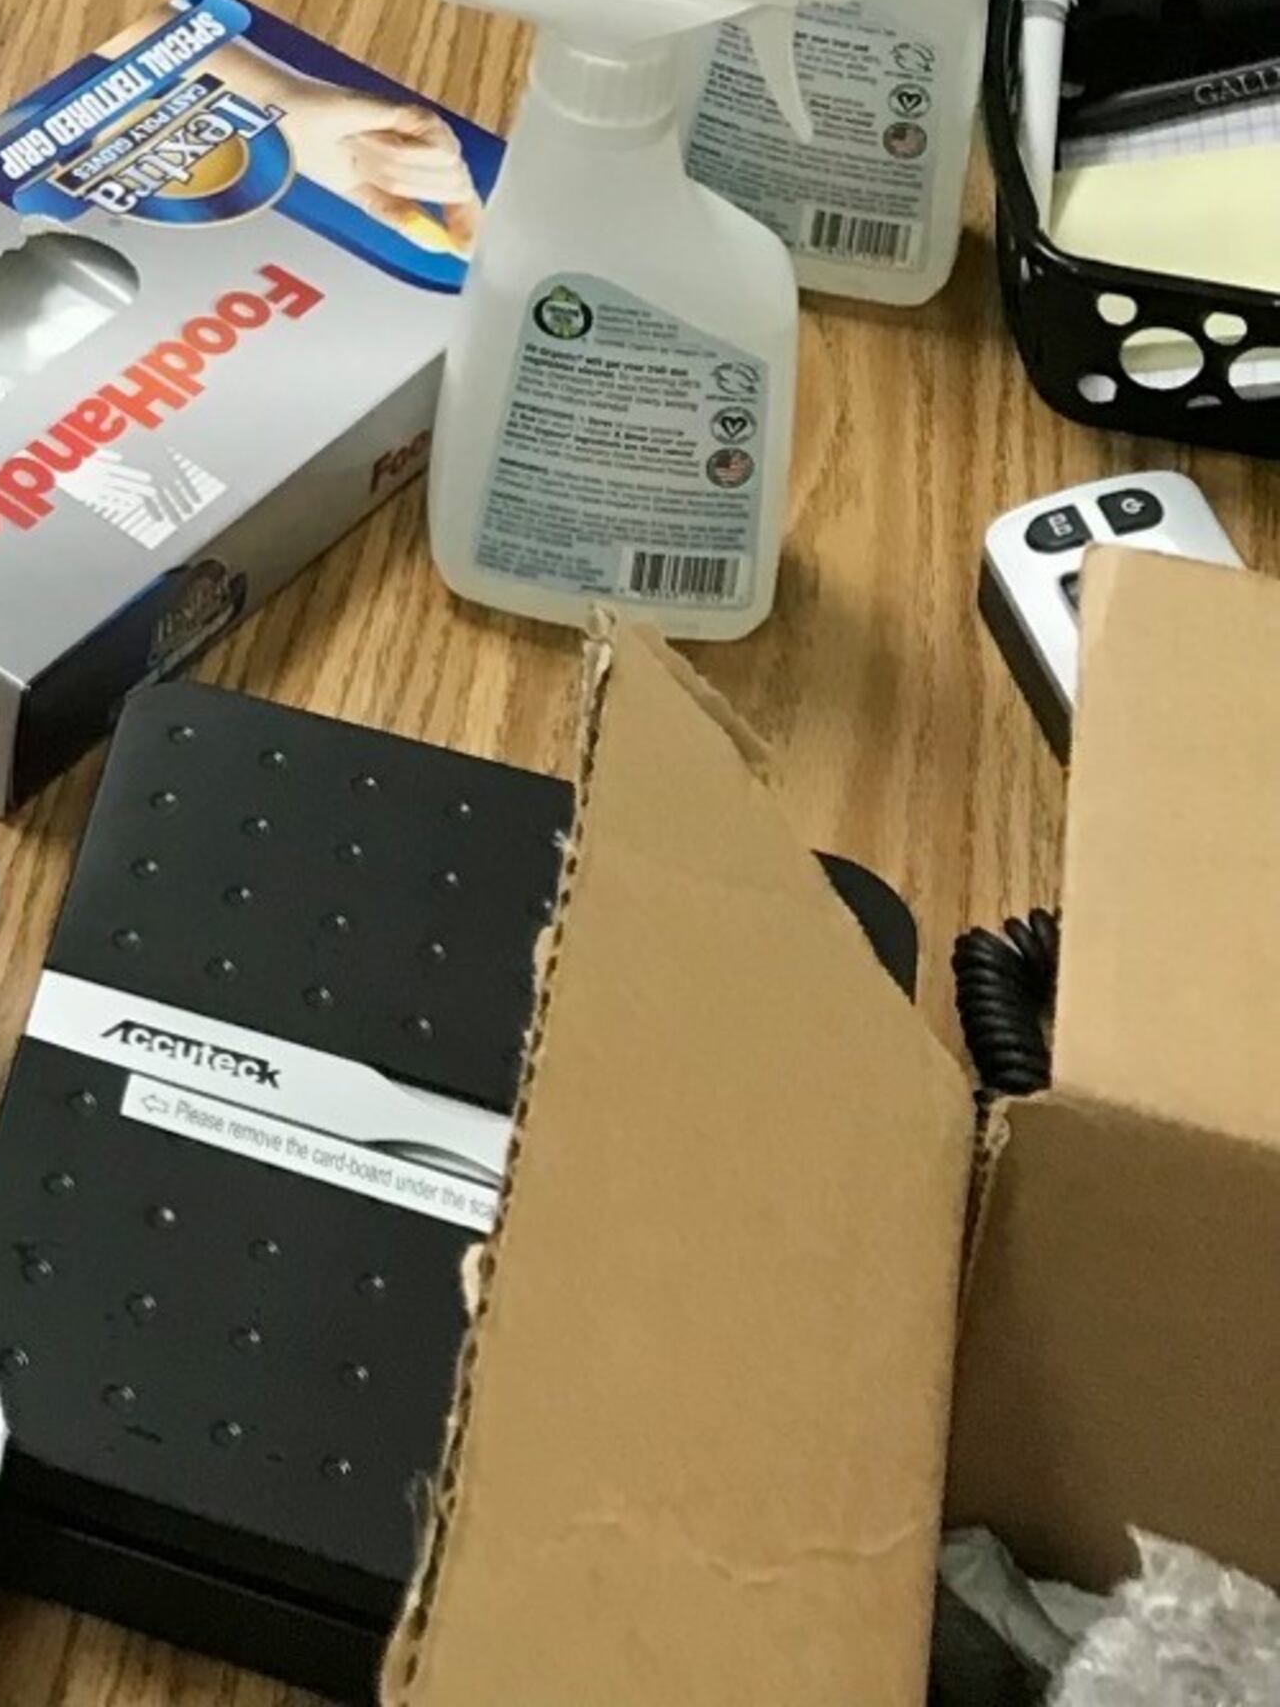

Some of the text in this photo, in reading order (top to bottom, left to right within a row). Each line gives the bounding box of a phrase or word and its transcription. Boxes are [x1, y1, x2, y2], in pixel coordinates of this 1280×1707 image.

[139, 8, 226, 81] SPECIAL
[43, 65, 153, 145] TEXTURED
[71, 83, 208, 181] CAST POLY GLOVES
[85, 91, 287, 215] Textra
[174, 1099, 225, 1134] Please
[227, 1120, 282, 1155] remove
[285, 1134, 311, 1160] the
[312, 1143, 394, 1188] card-board
[396, 1170, 440, 1202] under
[441, 1183, 469, 1209] the
